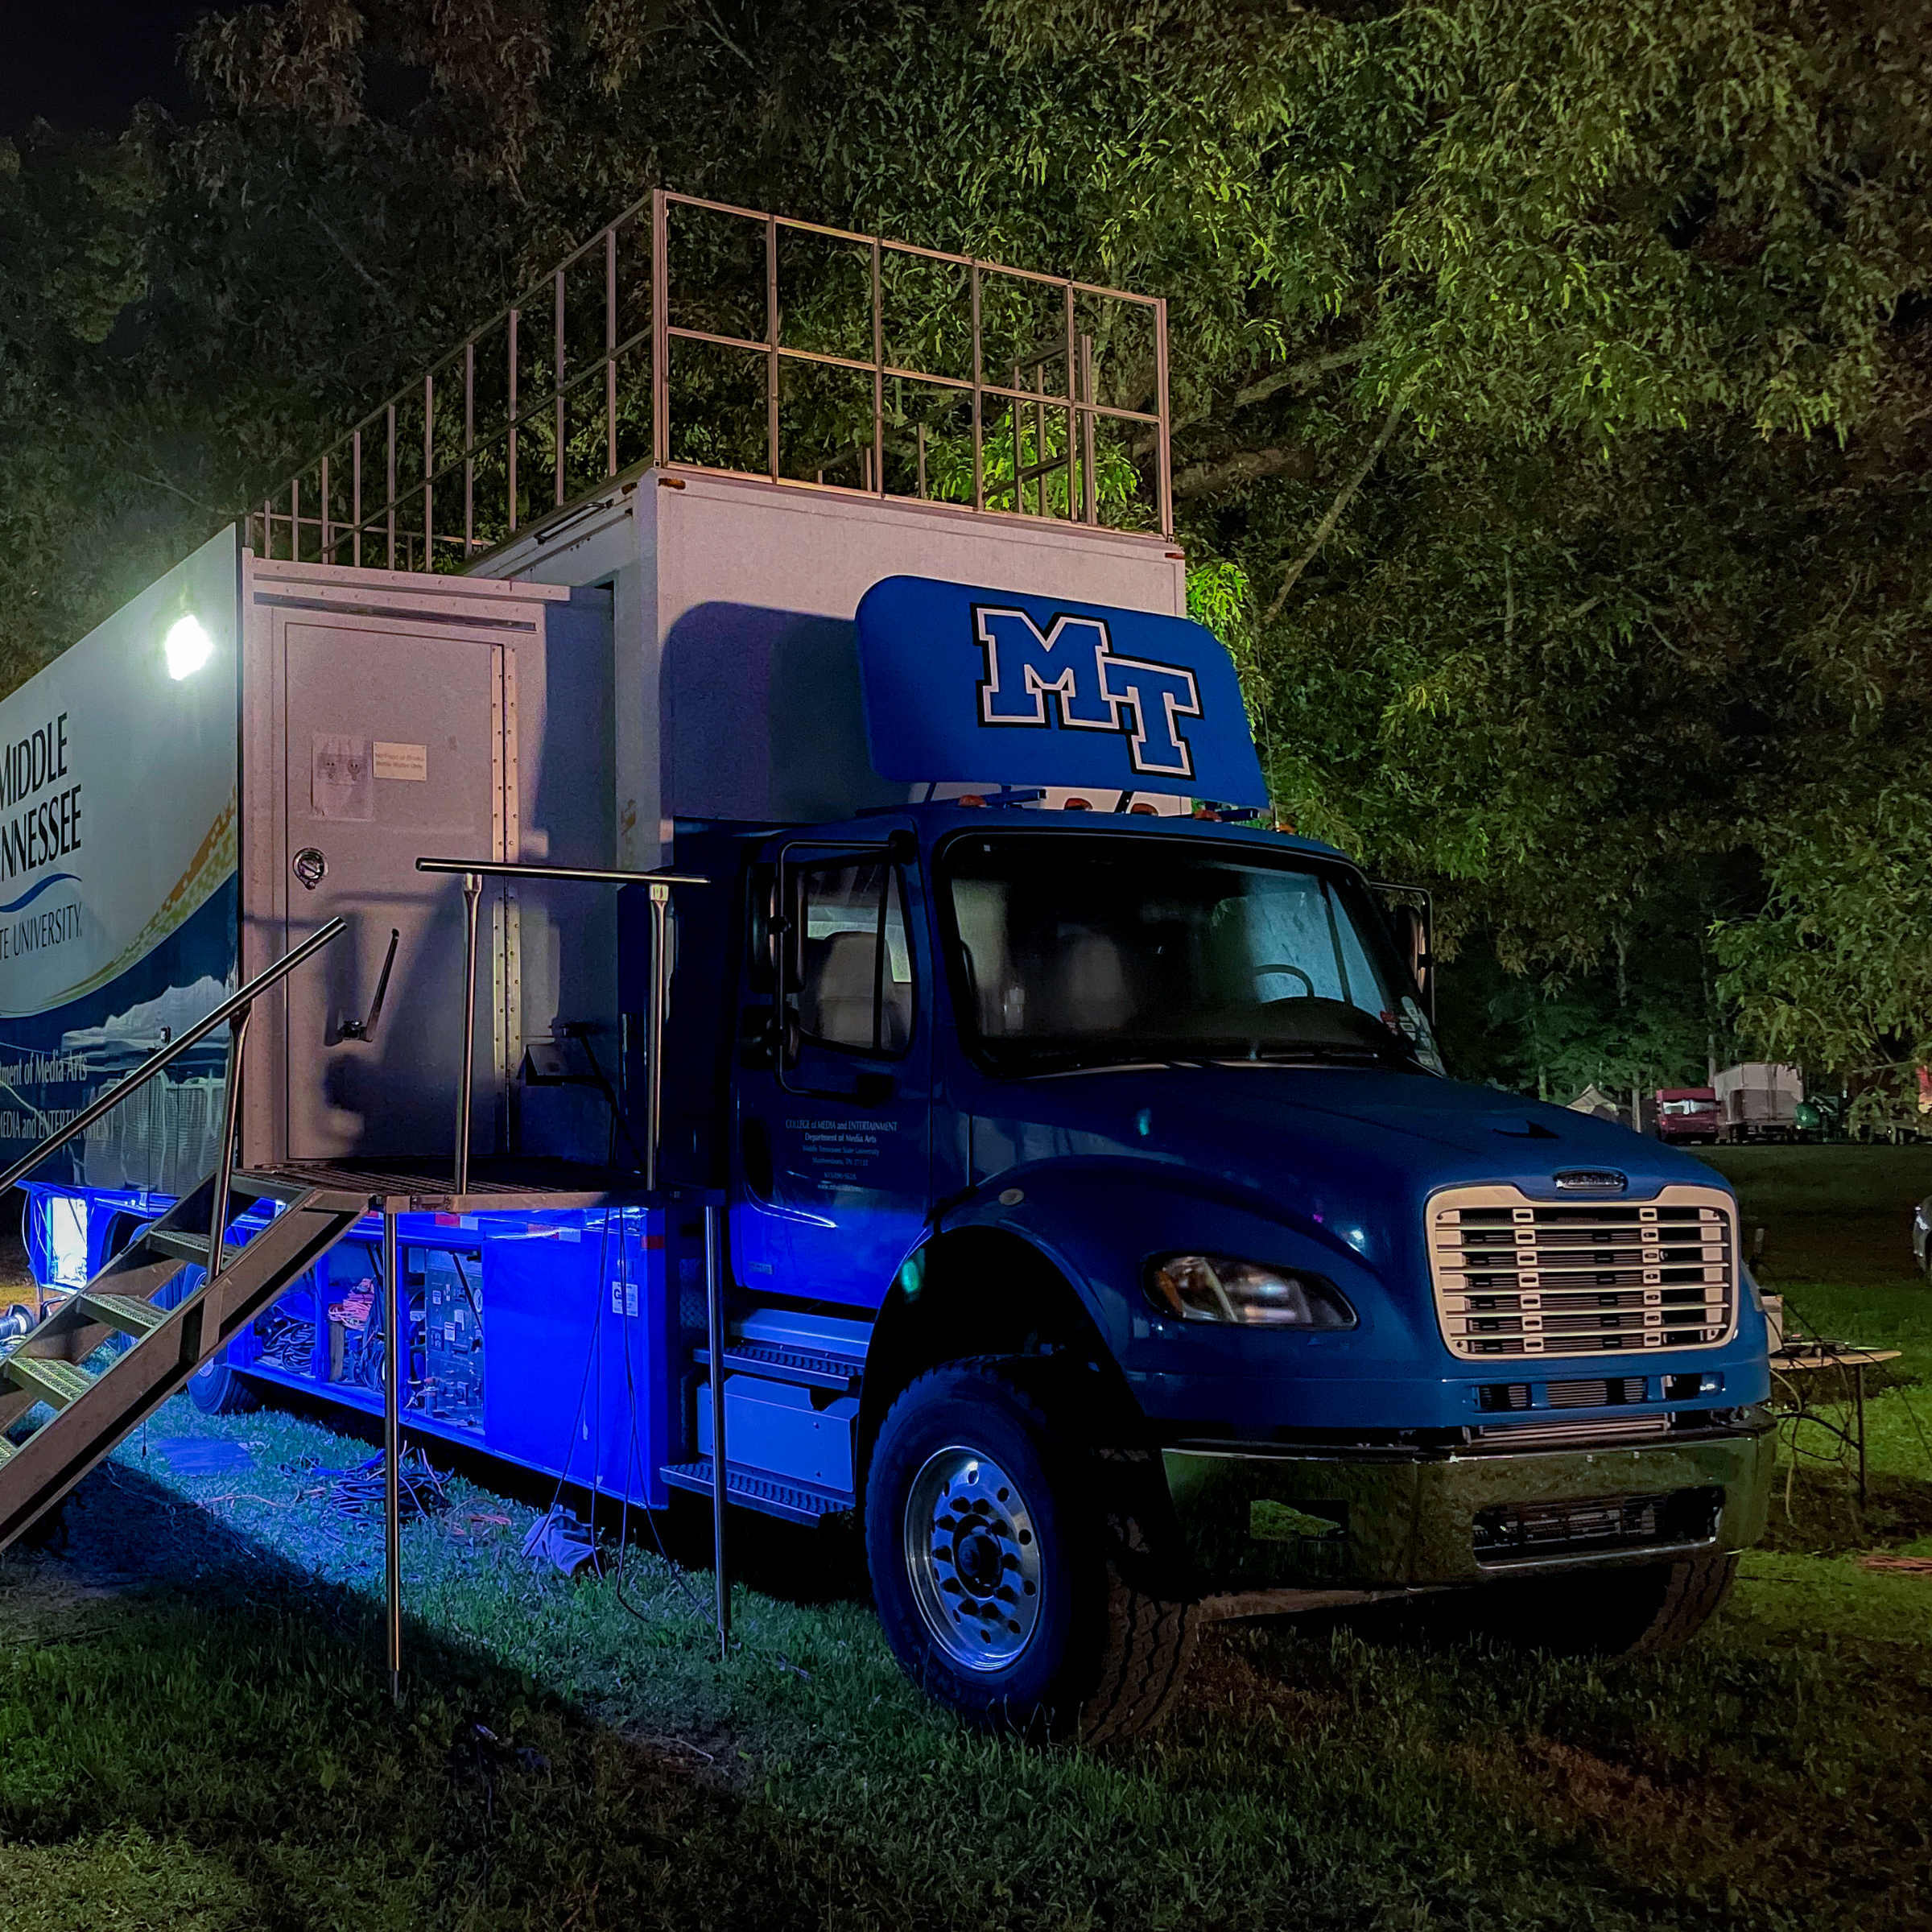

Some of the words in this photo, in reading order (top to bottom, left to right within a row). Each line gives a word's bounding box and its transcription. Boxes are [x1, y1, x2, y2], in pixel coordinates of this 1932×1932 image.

[970, 602, 1205, 782] MT
[0, 784, 82, 882] NNESSEE
[24, 1051, 35, 1085] of
[35, 1049, 64, 1084] Media
[66, 1049, 88, 1081] Arts
[22, 1110, 36, 1139] and
[786, 1119, 810, 1129] COLLEGE
[811, 1120, 817, 1129] of
[817, 1120, 836, 1130] MEDIA
[836, 1121, 848, 1130] and
[848, 1121, 898, 1132] ENTERTAINMENT
[805, 1133, 837, 1143] Department
[838, 1133, 844, 1141] of
[845, 1133, 864, 1143] Media
[865, 1134, 877, 1144] Arts
